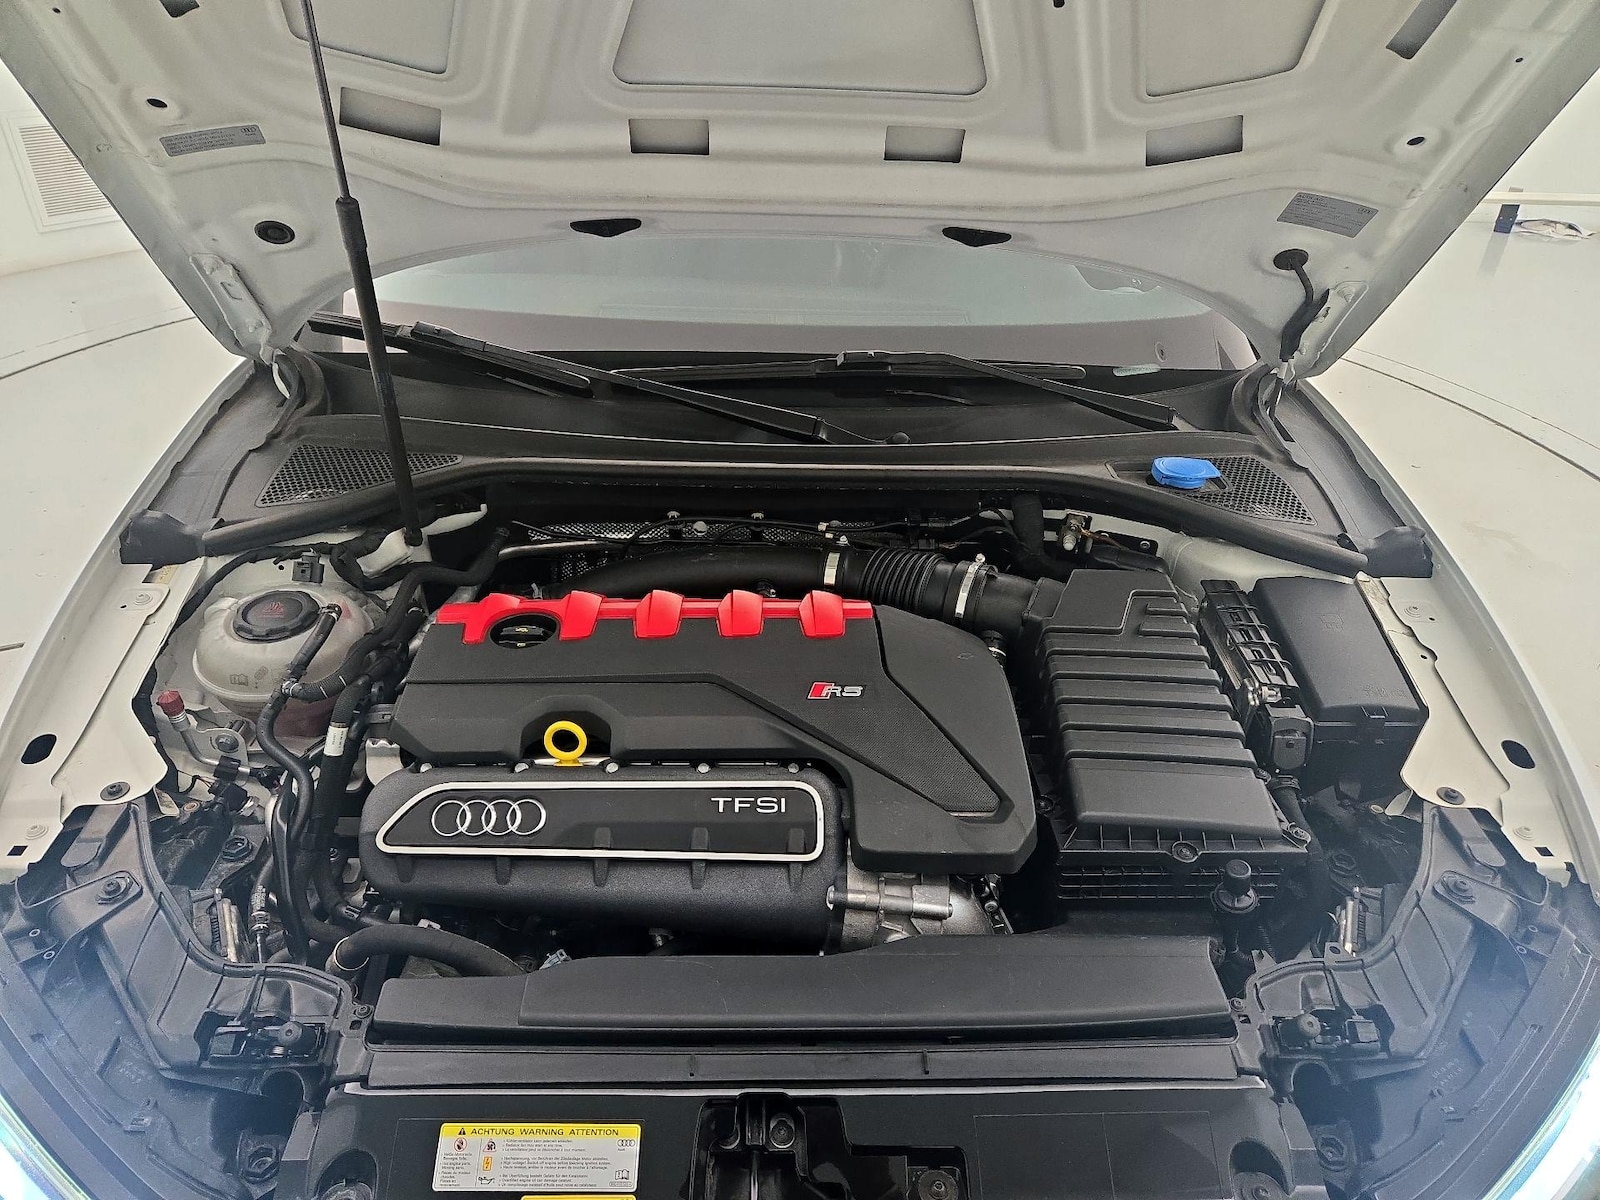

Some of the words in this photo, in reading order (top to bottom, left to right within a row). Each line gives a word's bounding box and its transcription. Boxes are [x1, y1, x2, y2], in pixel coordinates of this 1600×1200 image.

[711, 797, 786, 813] TFSI
[470, 1128, 515, 1136] ACHTUNG
[519, 1128, 564, 1136] WARNING
[568, 1128, 619, 1136] ATTENTION
